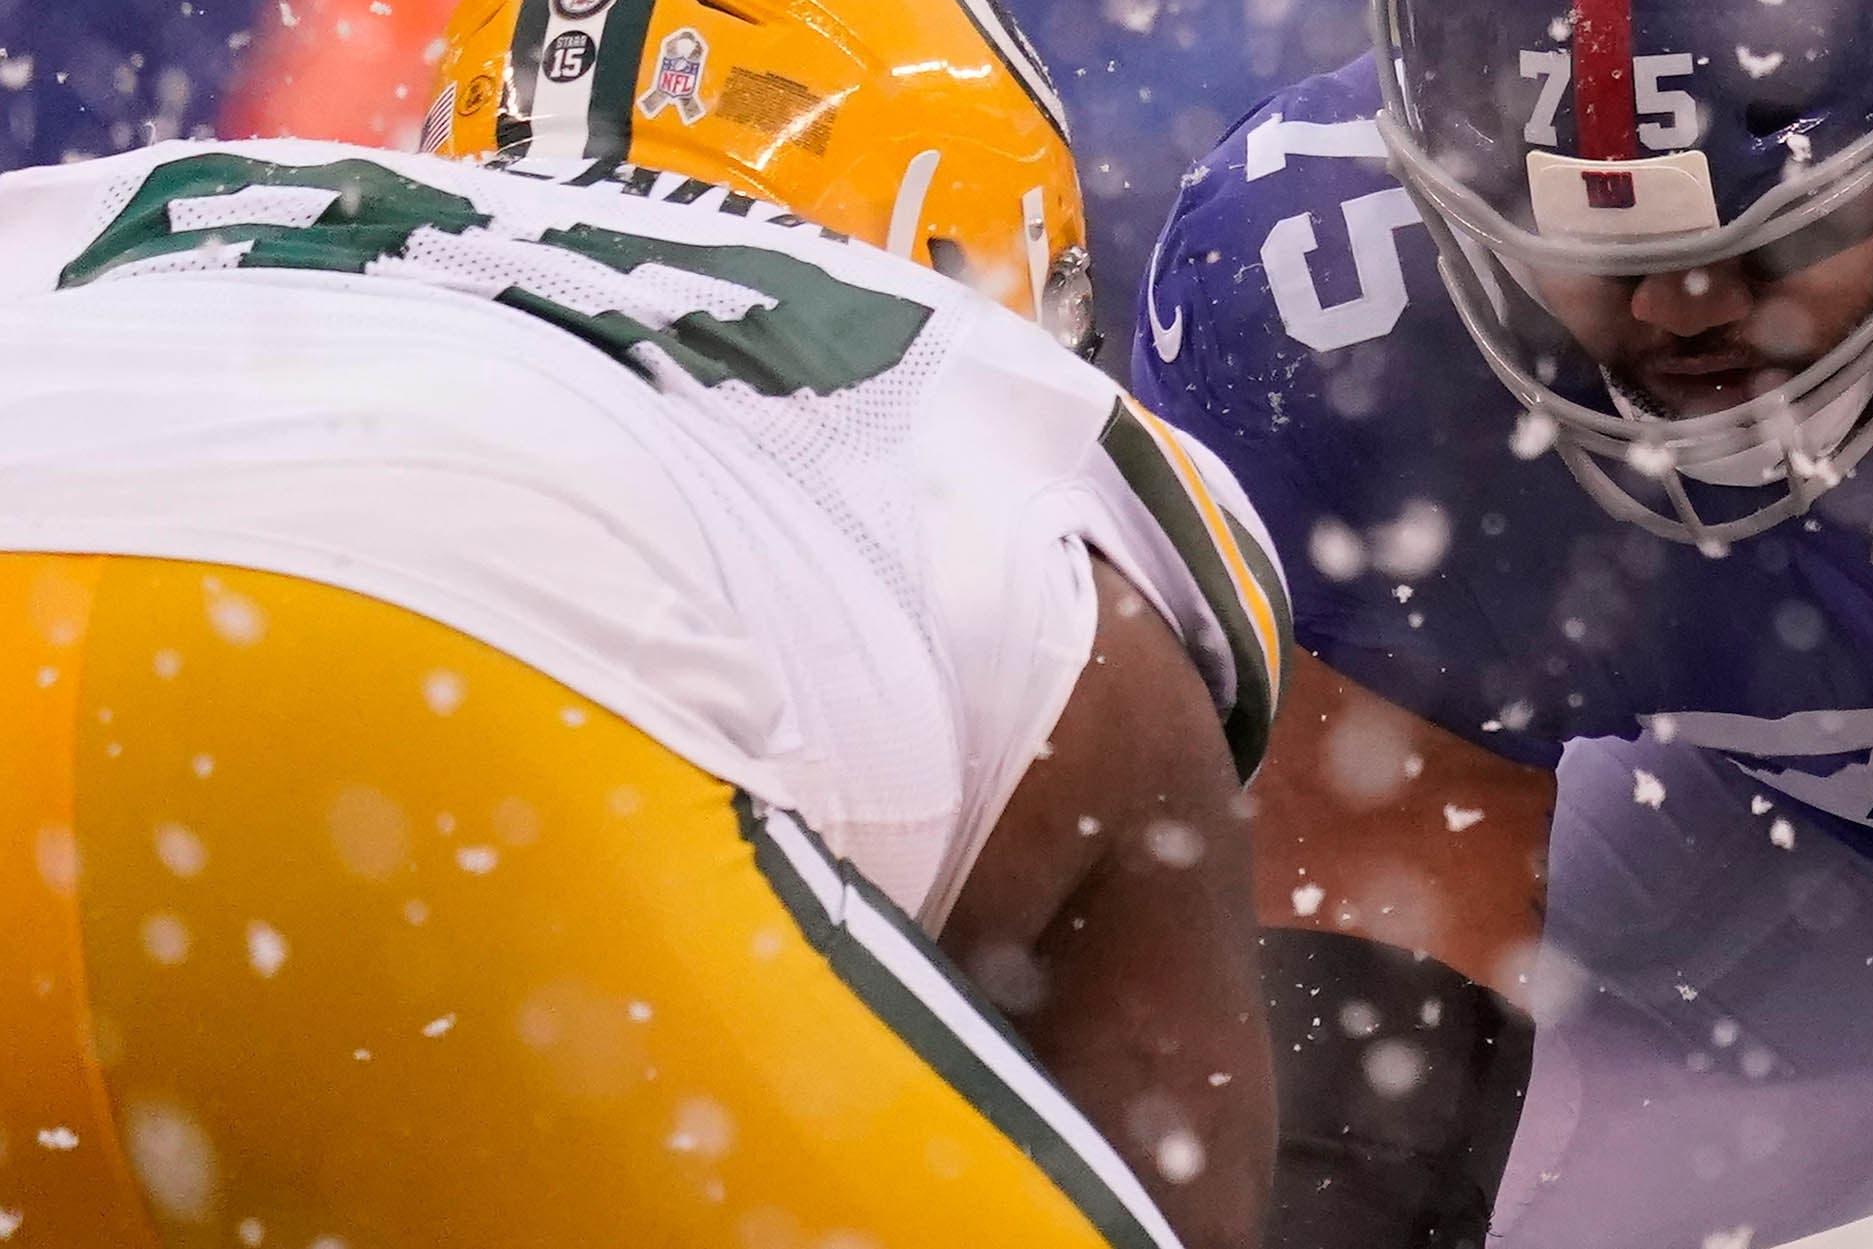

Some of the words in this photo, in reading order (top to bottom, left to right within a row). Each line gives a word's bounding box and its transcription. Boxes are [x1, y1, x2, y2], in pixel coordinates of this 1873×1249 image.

[550, 48, 586, 77] 15
[661, 71, 691, 93] NFL
[1519, 52, 1698, 150] 75
